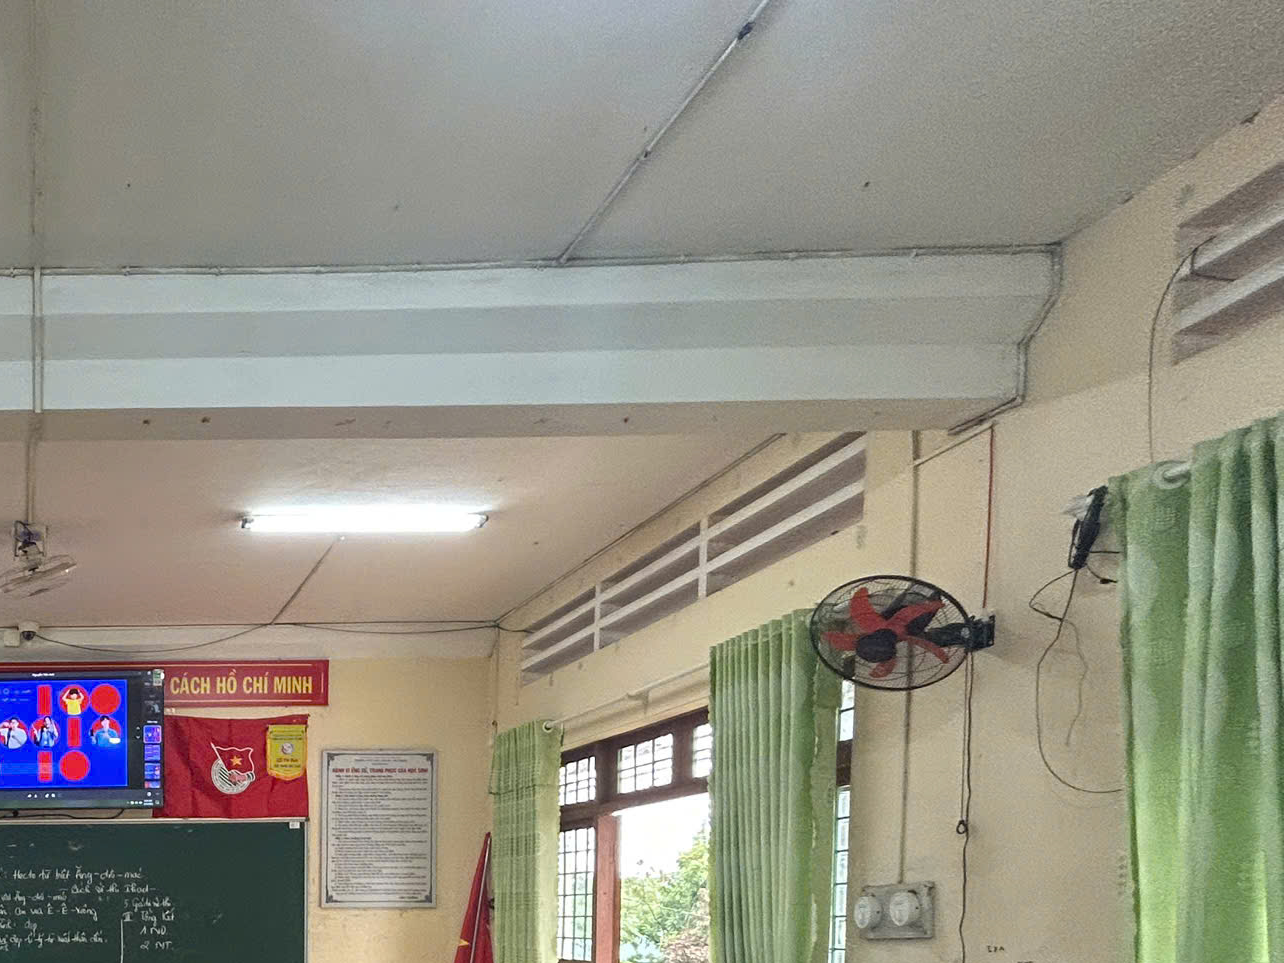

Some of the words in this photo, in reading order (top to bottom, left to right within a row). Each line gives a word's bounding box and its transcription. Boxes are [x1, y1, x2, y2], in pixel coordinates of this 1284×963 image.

[170, 672, 211, 694] CÁCH
[216, 668, 238, 694] HỒ
[242, 672, 269, 694] CHÍ
[273, 676, 313, 694] MINH
